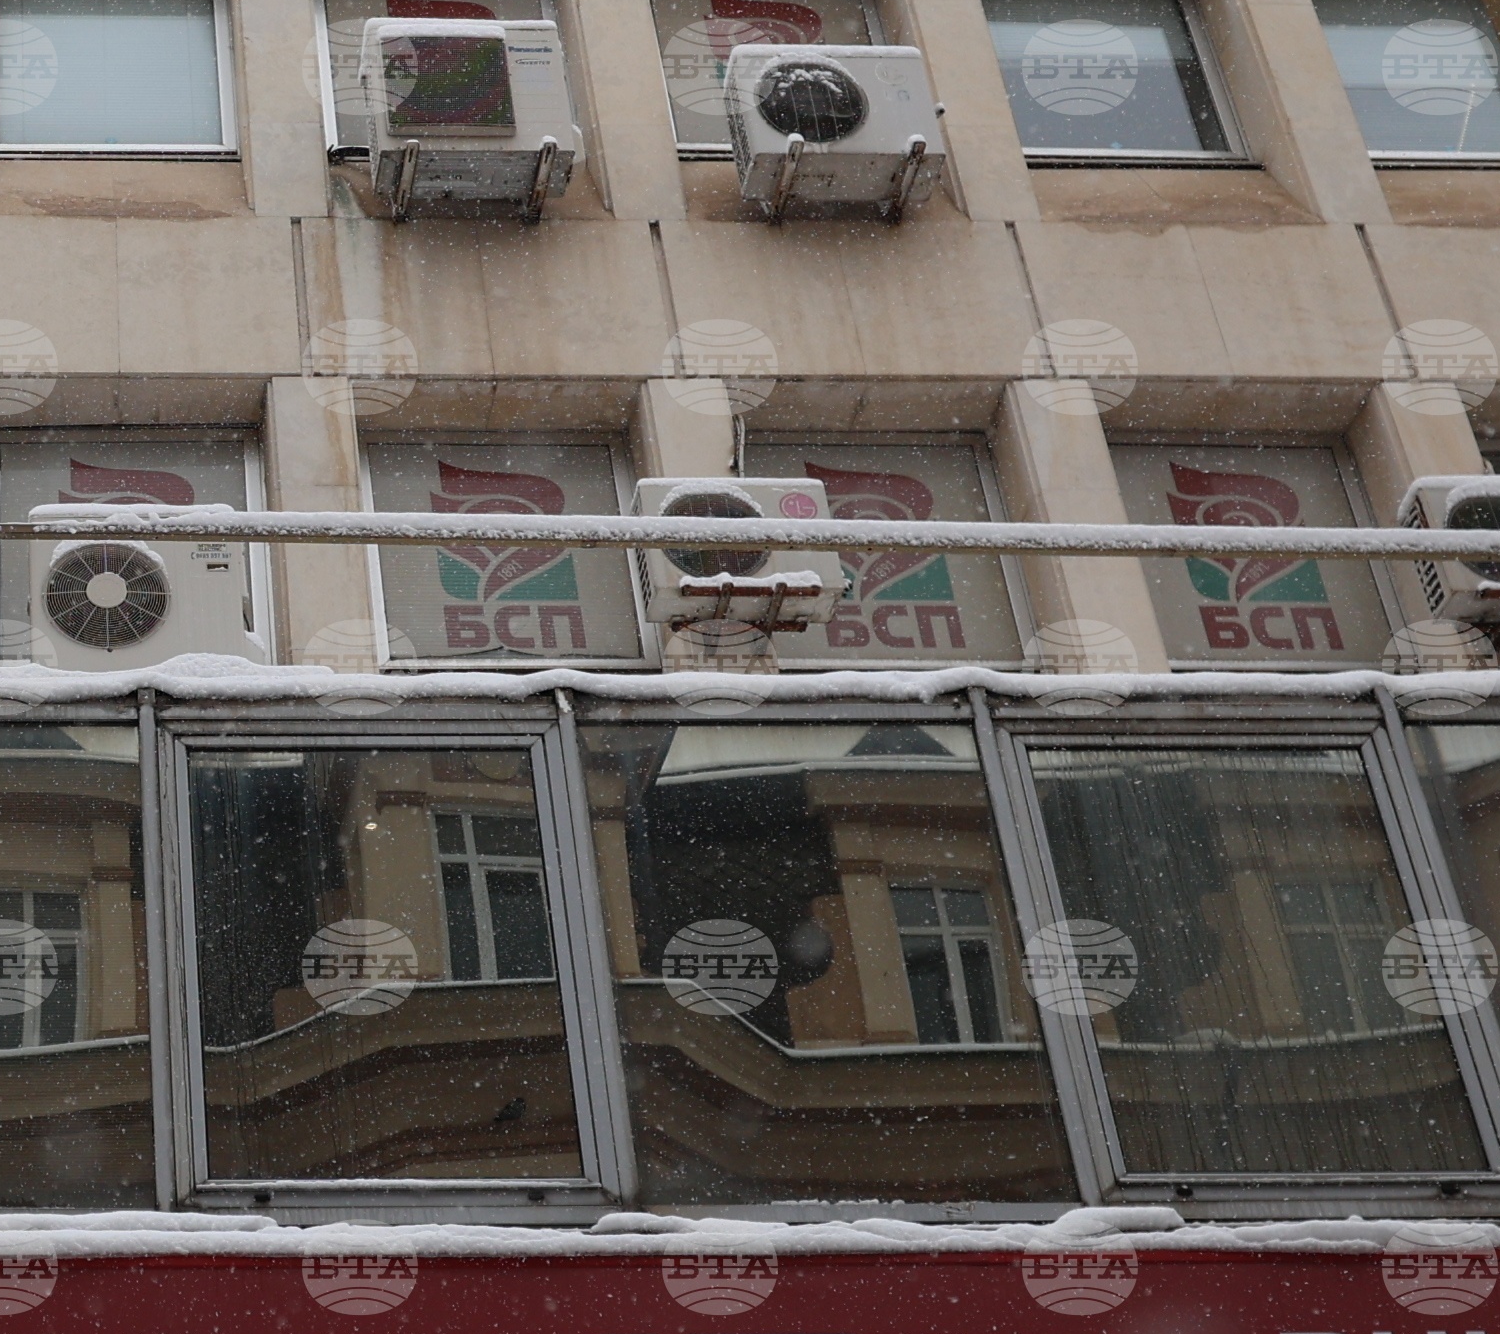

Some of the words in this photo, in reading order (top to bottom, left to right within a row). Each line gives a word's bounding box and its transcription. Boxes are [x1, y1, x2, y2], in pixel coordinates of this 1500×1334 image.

[497, 559, 523, 580] 1891
[872, 560, 896, 581] 1891
[445, 605, 587, 649] БСП
[826, 605, 966, 649] БСП
[1198, 606, 1344, 650] БСП
